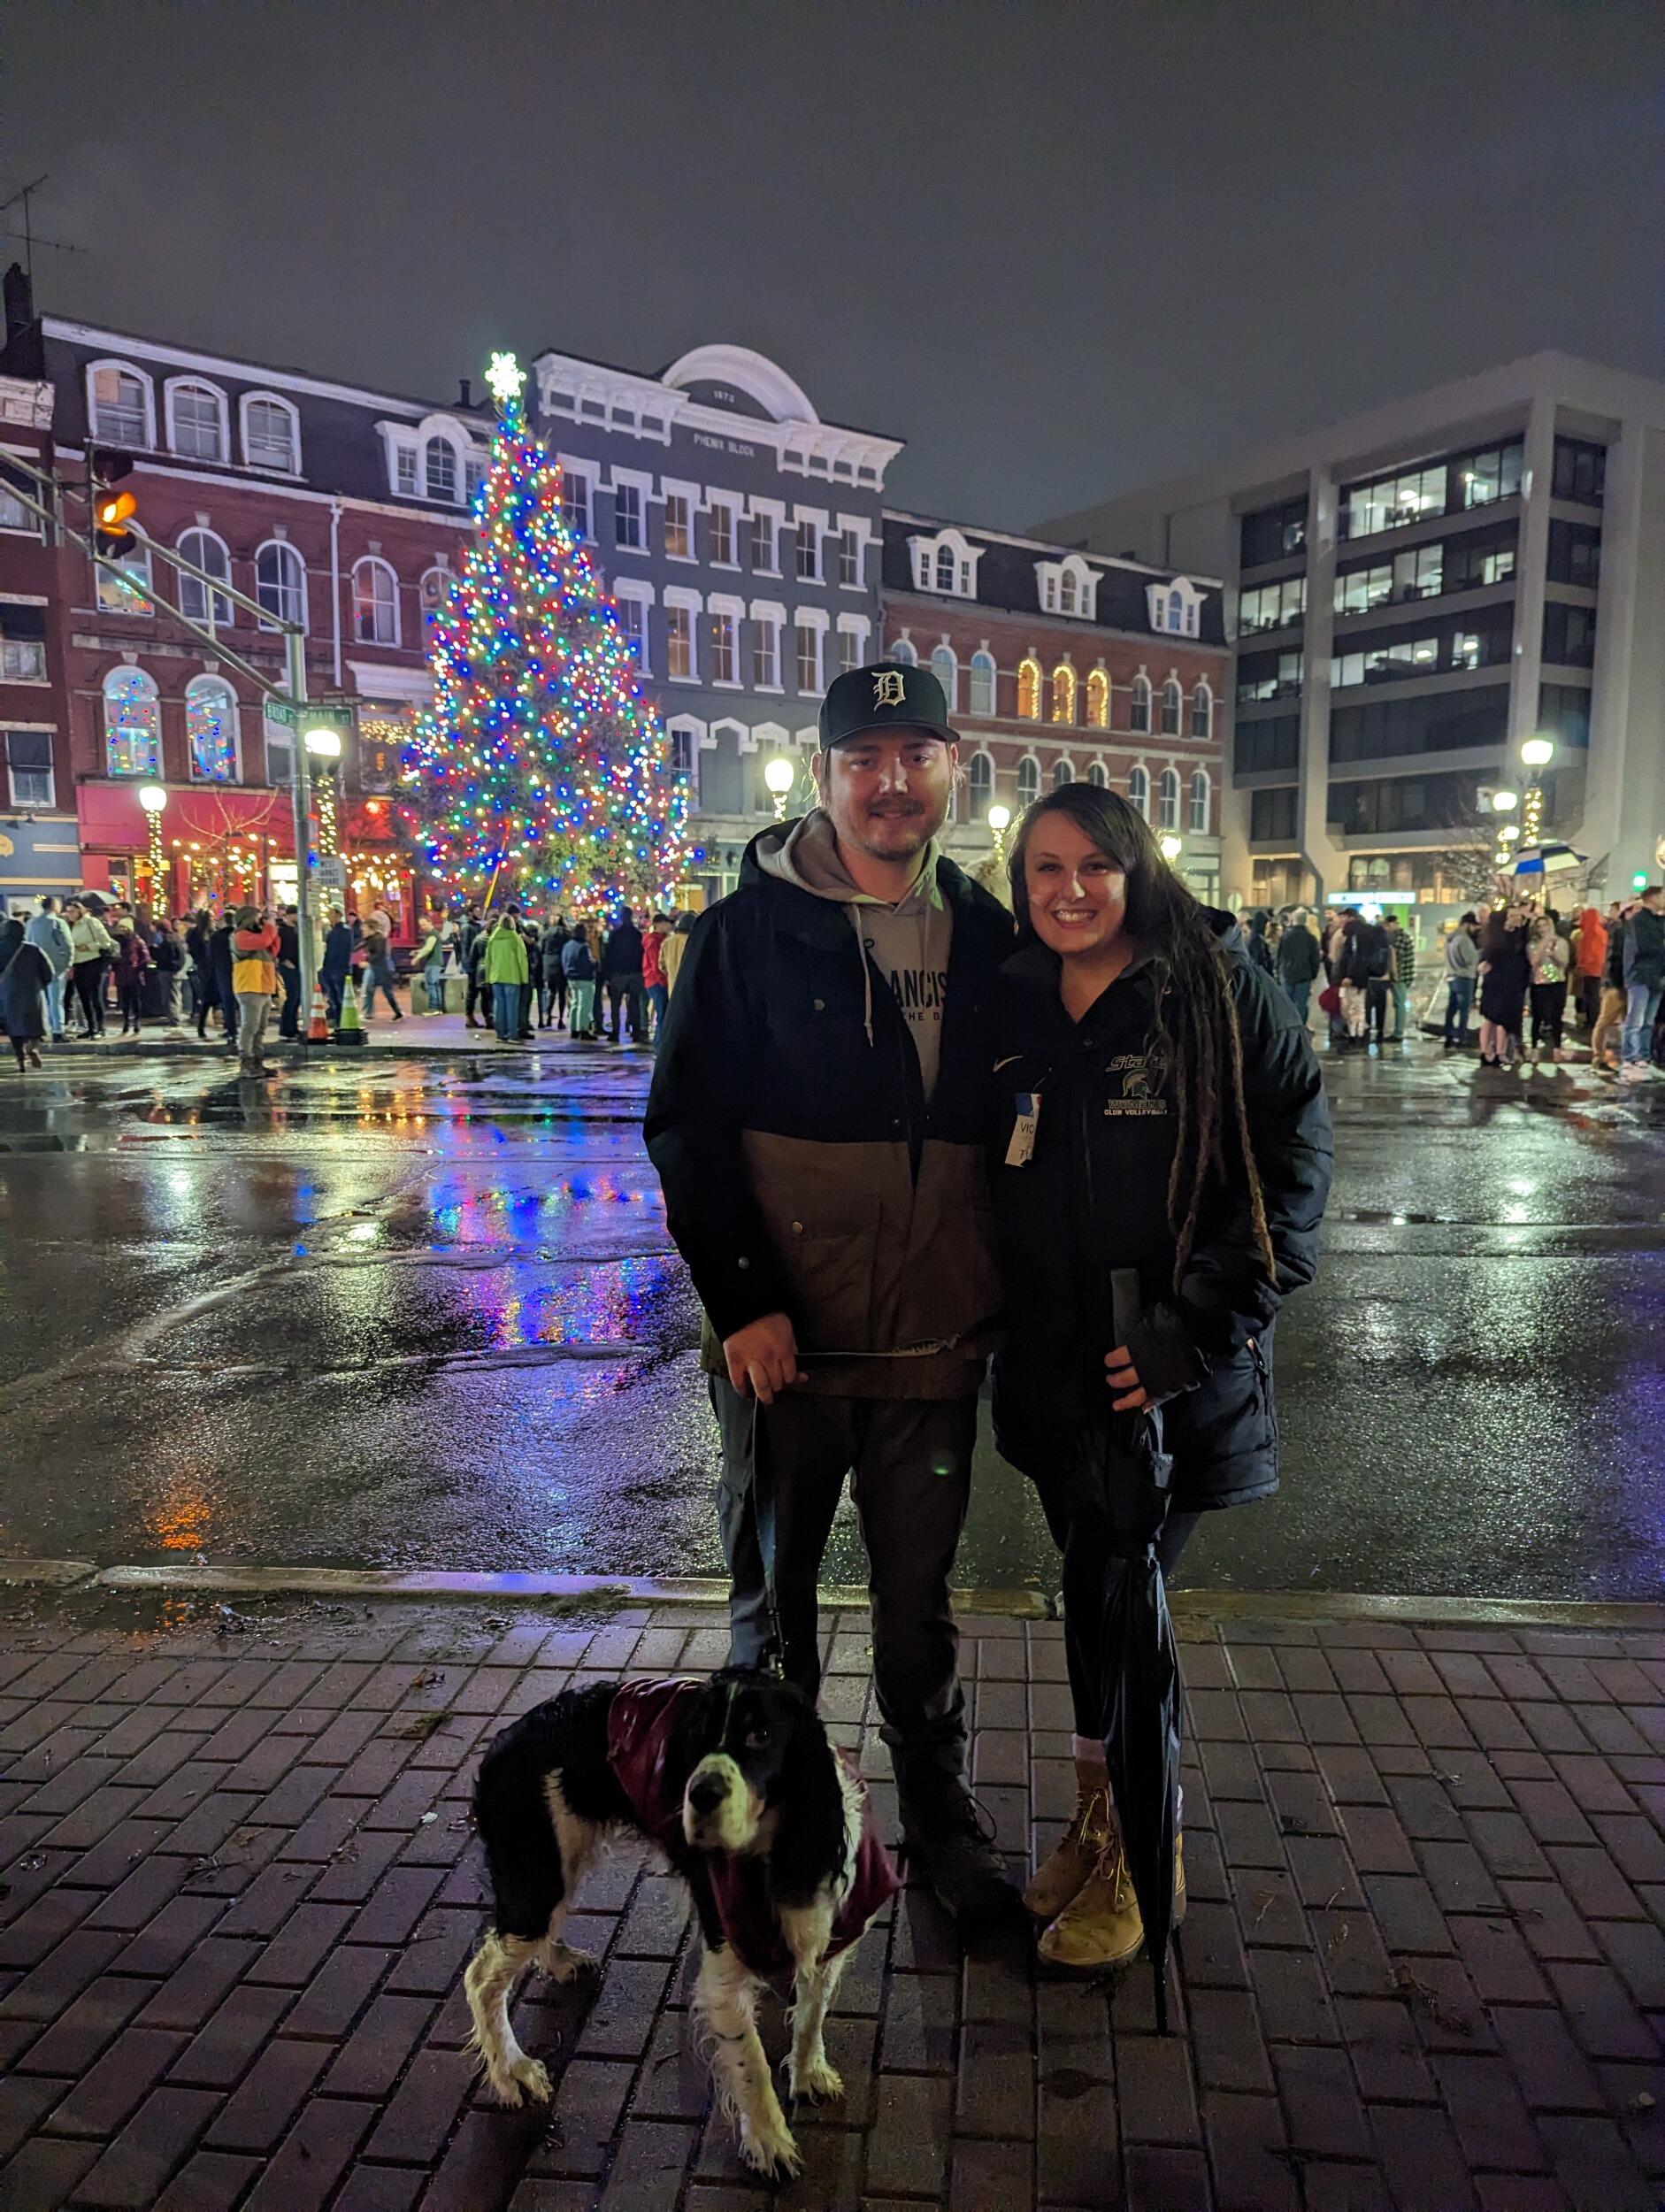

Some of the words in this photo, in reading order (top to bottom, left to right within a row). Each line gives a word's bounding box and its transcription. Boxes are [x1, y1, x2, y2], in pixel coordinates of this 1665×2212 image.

[694, 433, 724, 450] PHENIX
[728, 442, 756, 457] BLOCK
[871, 671, 906, 711] D
[267, 704, 288, 723] BROAD
[310, 710, 335, 725] MAIN
[891, 970, 948, 1008] ANCIS
[909, 1012, 925, 1021] HE
[1105, 1055, 1168, 1071] Stae
